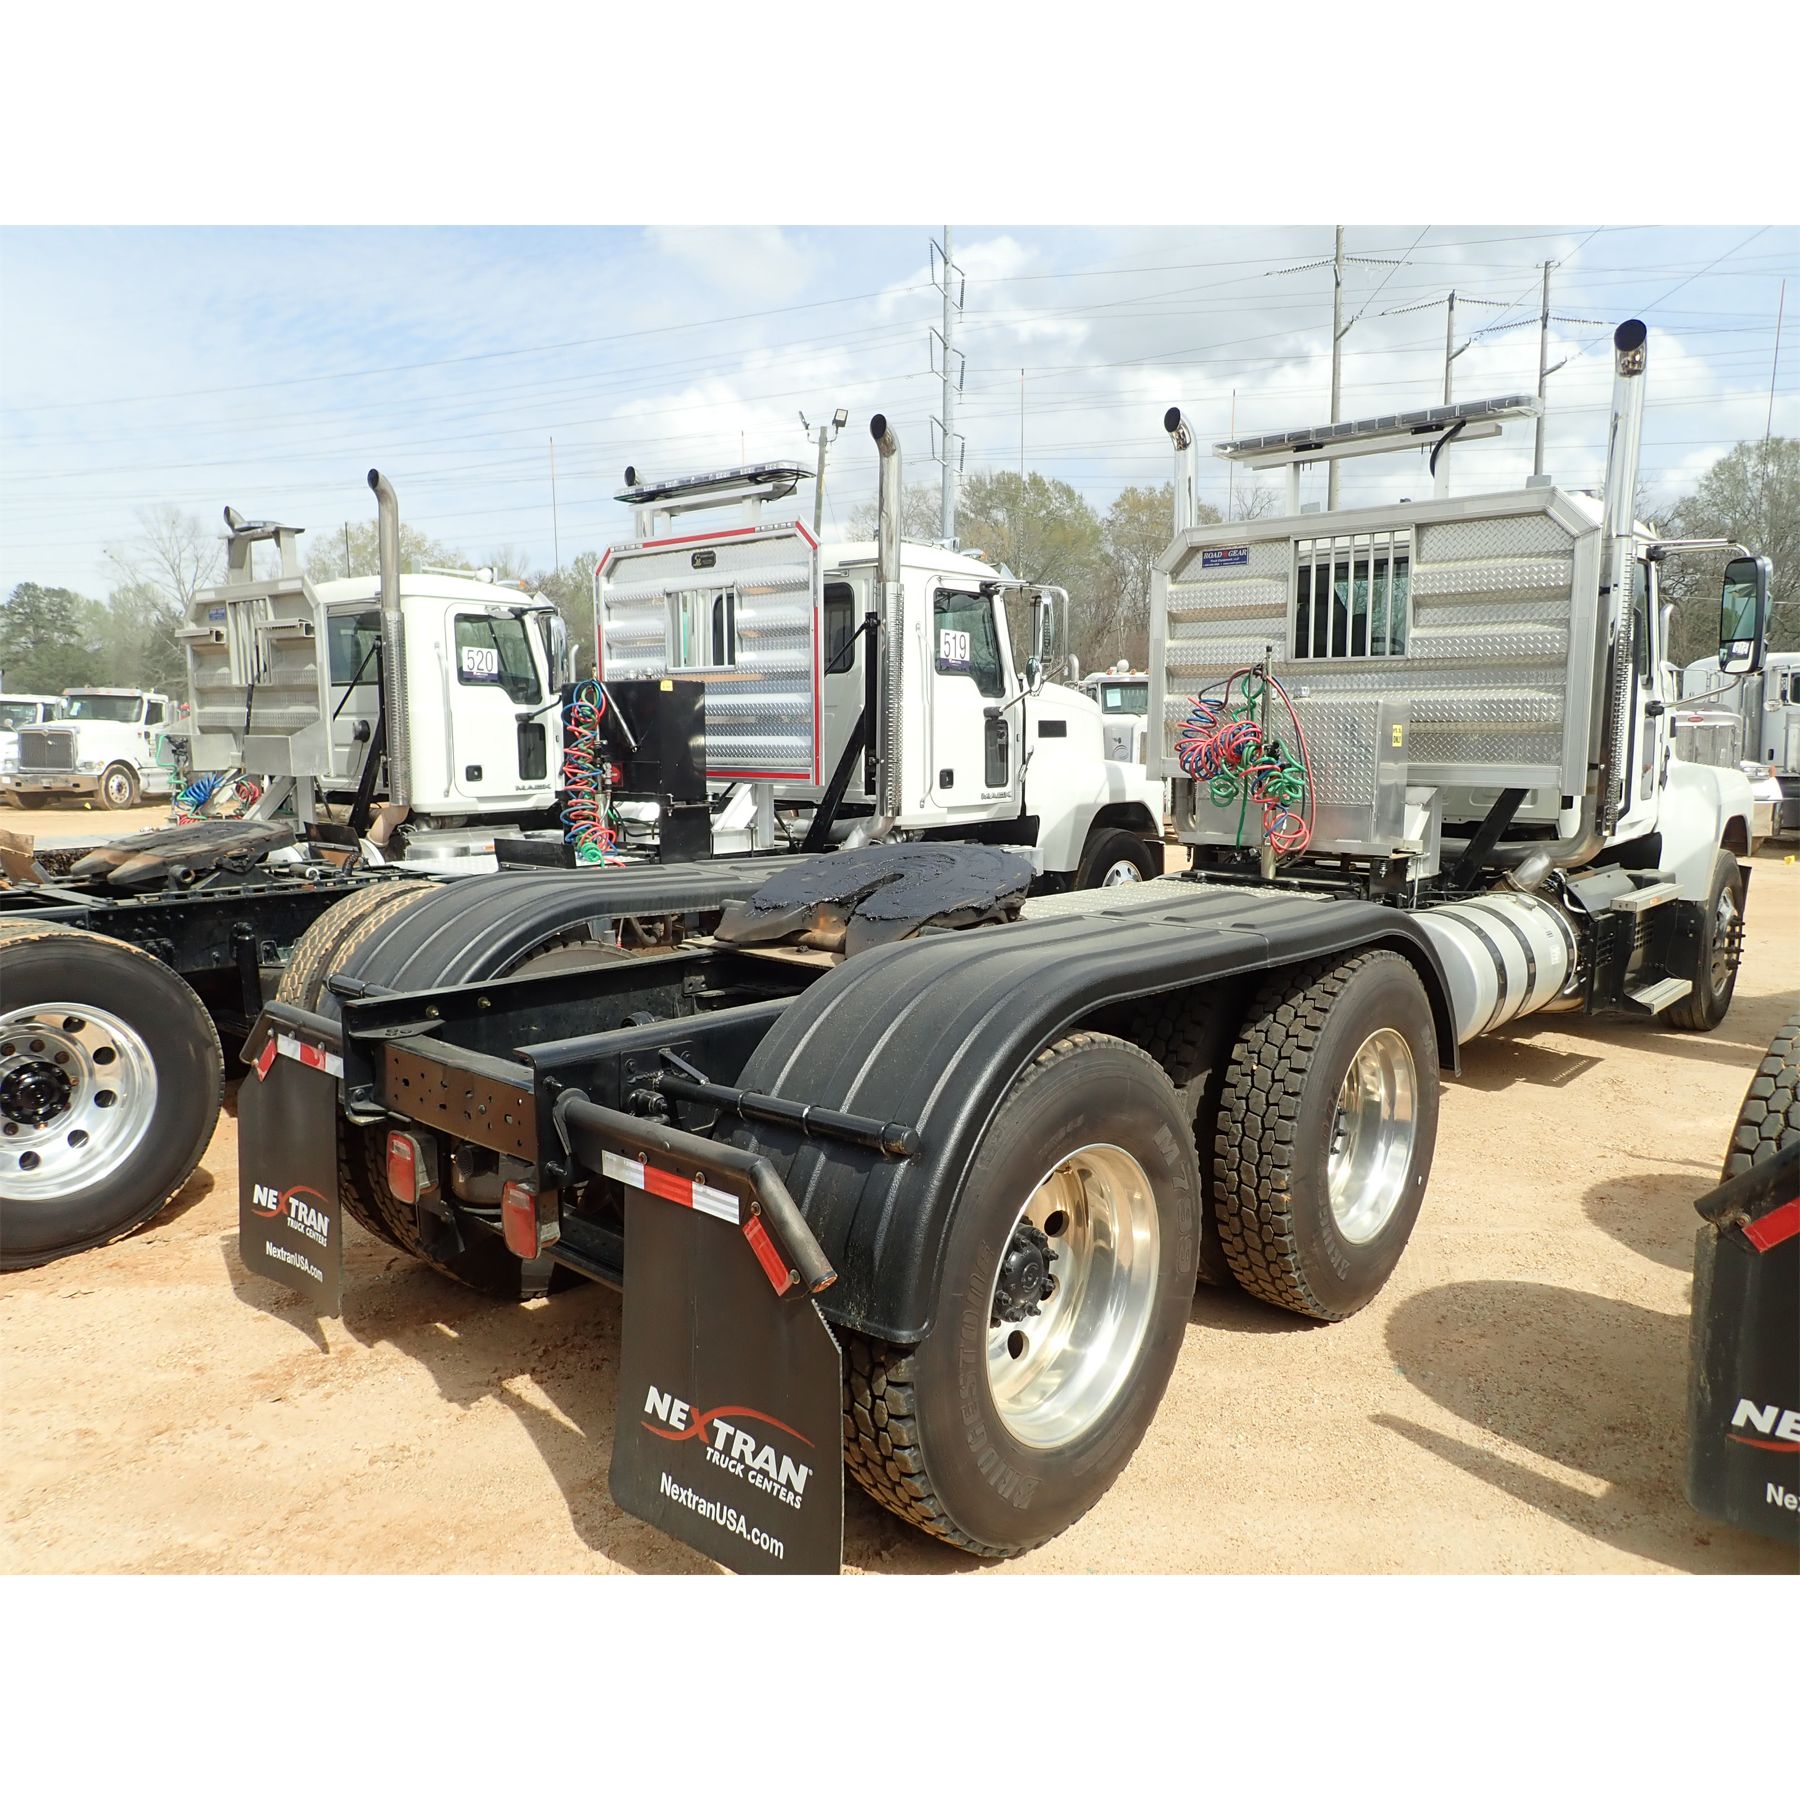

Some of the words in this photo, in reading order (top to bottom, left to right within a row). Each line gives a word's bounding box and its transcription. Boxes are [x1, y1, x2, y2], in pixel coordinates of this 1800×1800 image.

[1203, 551, 1222, 559] ROAD
[1228, 549, 1247, 557] GEAR
[467, 649, 494, 672] 520
[943, 632, 967, 659] 519
[252, 1183, 330, 1237] NEXTRAN
[287, 1216, 305, 1234] TRUCK
[305, 1227, 327, 1247] CENTERS
[265, 1240, 323, 1283] NextranUSA.com
[958, 1240, 1042, 1510] BRIDGESTONE
[705, 1446, 745, 1479] TRUCK
[747, 1470, 803, 1510] CENTERS
[659, 1471, 785, 1560] NextranUSA.com
[1766, 1482, 1800, 1512] Ne
